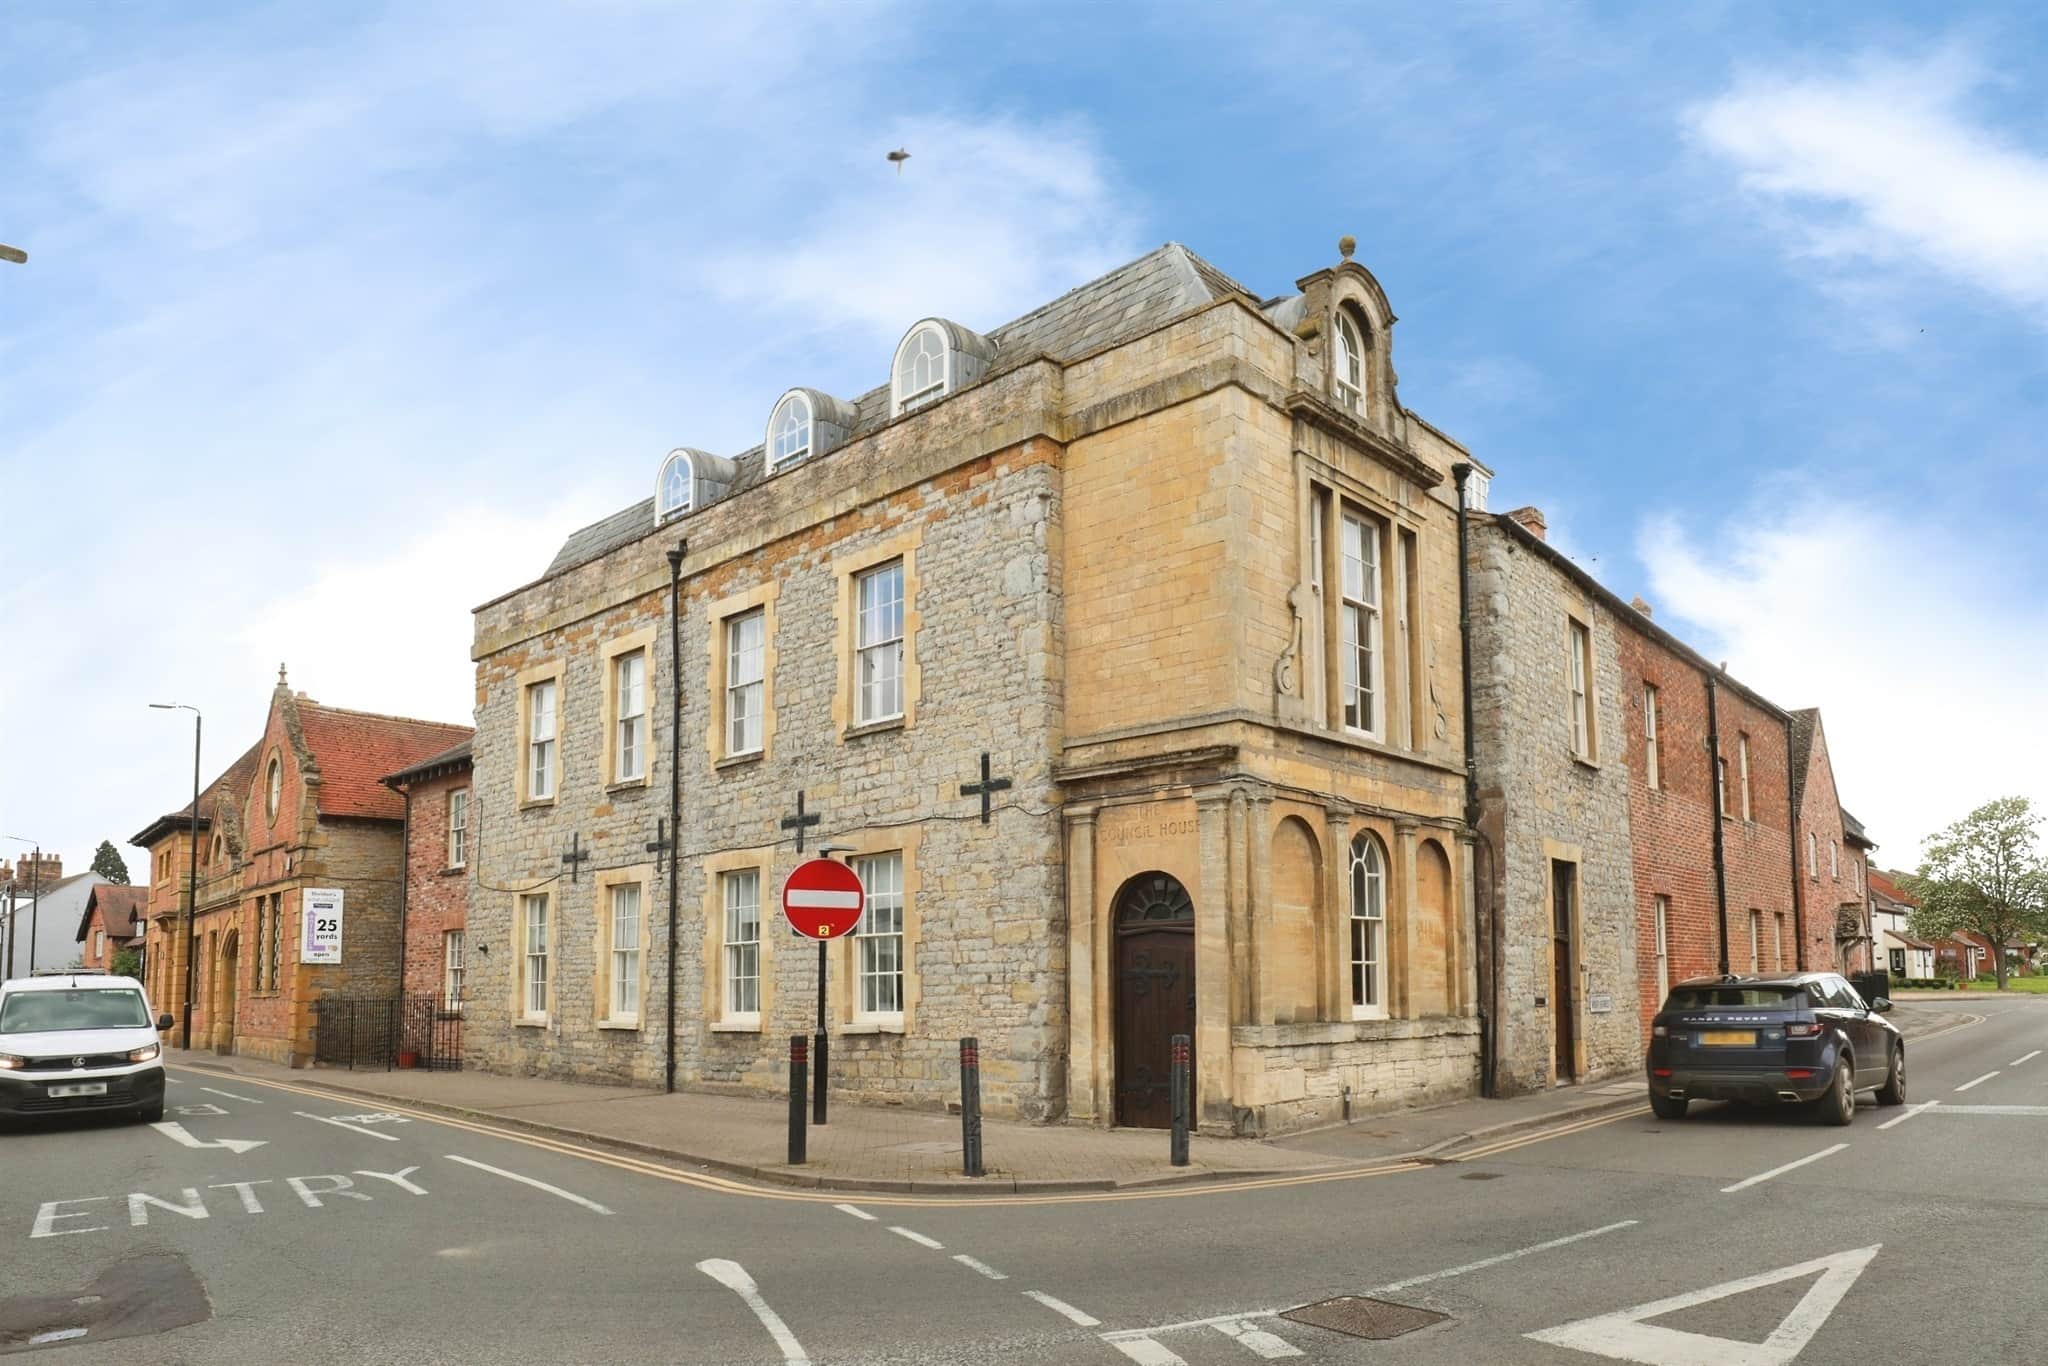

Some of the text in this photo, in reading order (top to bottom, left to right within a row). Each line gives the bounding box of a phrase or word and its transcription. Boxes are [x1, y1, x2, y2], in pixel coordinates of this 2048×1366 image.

[1138, 804, 1161, 817] THE
[1100, 819, 1201, 842] COUNCIL HOUSE
[317, 919, 337, 932] 25
[820, 926, 827, 935] 2
[316, 933, 338, 941] yards
[29, 1166, 430, 1238] ENTRY
